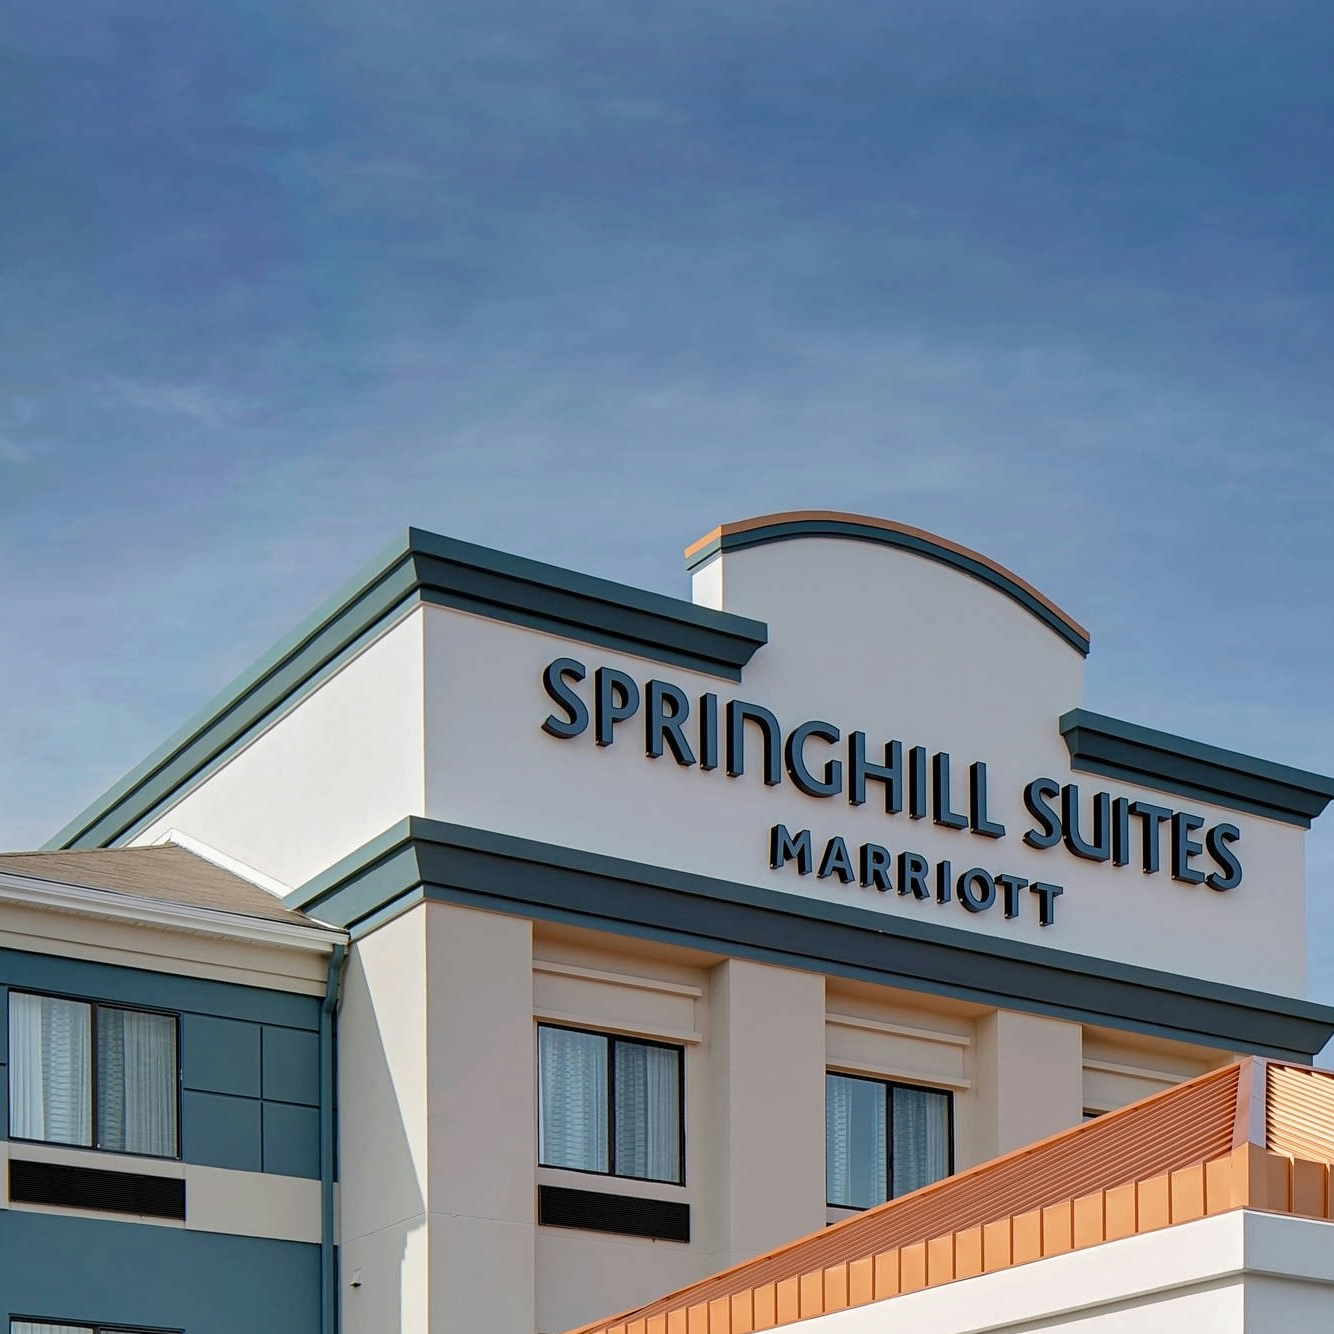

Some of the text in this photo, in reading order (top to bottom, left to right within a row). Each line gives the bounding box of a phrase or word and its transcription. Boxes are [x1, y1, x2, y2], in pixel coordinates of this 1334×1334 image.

[540, 657, 1243, 892] SPRINGHILL SUITES
[770, 824, 1064, 927] MARRIOTT
